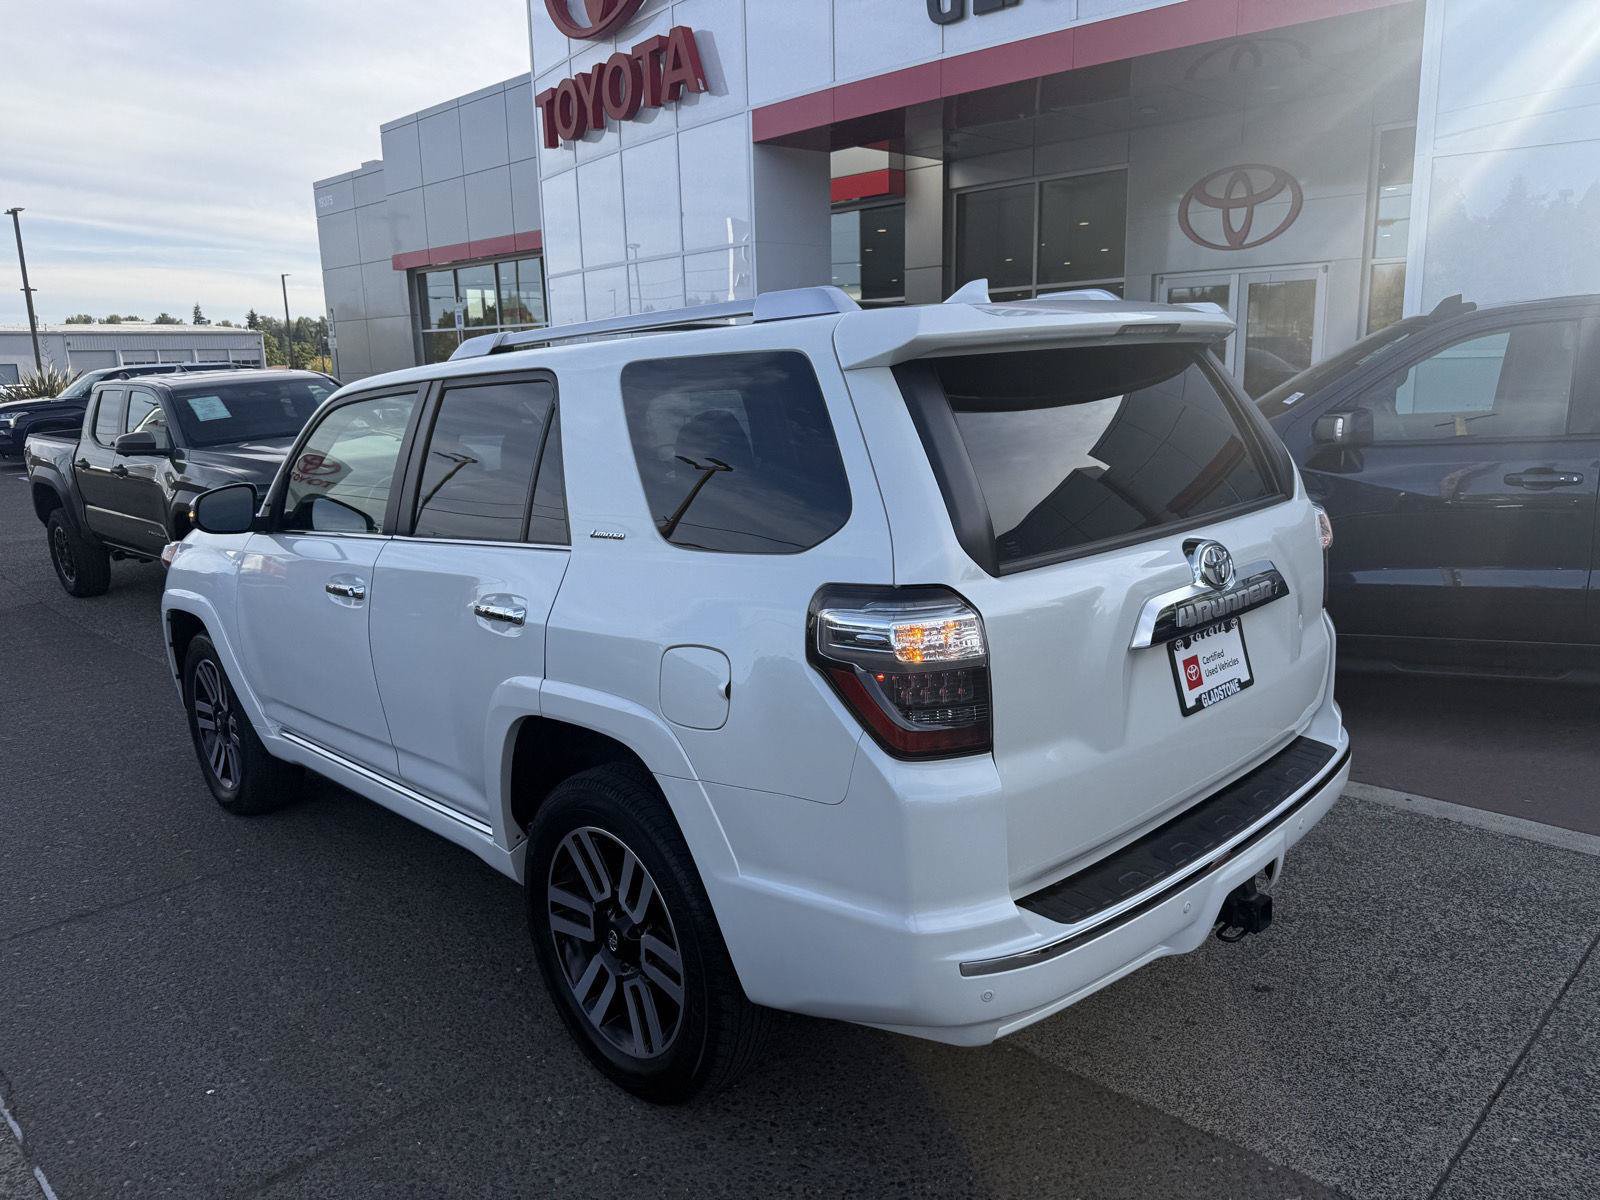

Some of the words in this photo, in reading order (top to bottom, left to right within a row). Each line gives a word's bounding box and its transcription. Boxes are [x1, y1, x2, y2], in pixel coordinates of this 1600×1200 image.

[534, 25, 709, 149] TOYOTA
[1202, 649, 1225, 665] Certified
[1204, 666, 1219, 677] Used
[1218, 657, 1240, 671] Vehicles
[1201, 678, 1240, 707] GLADSTONE
